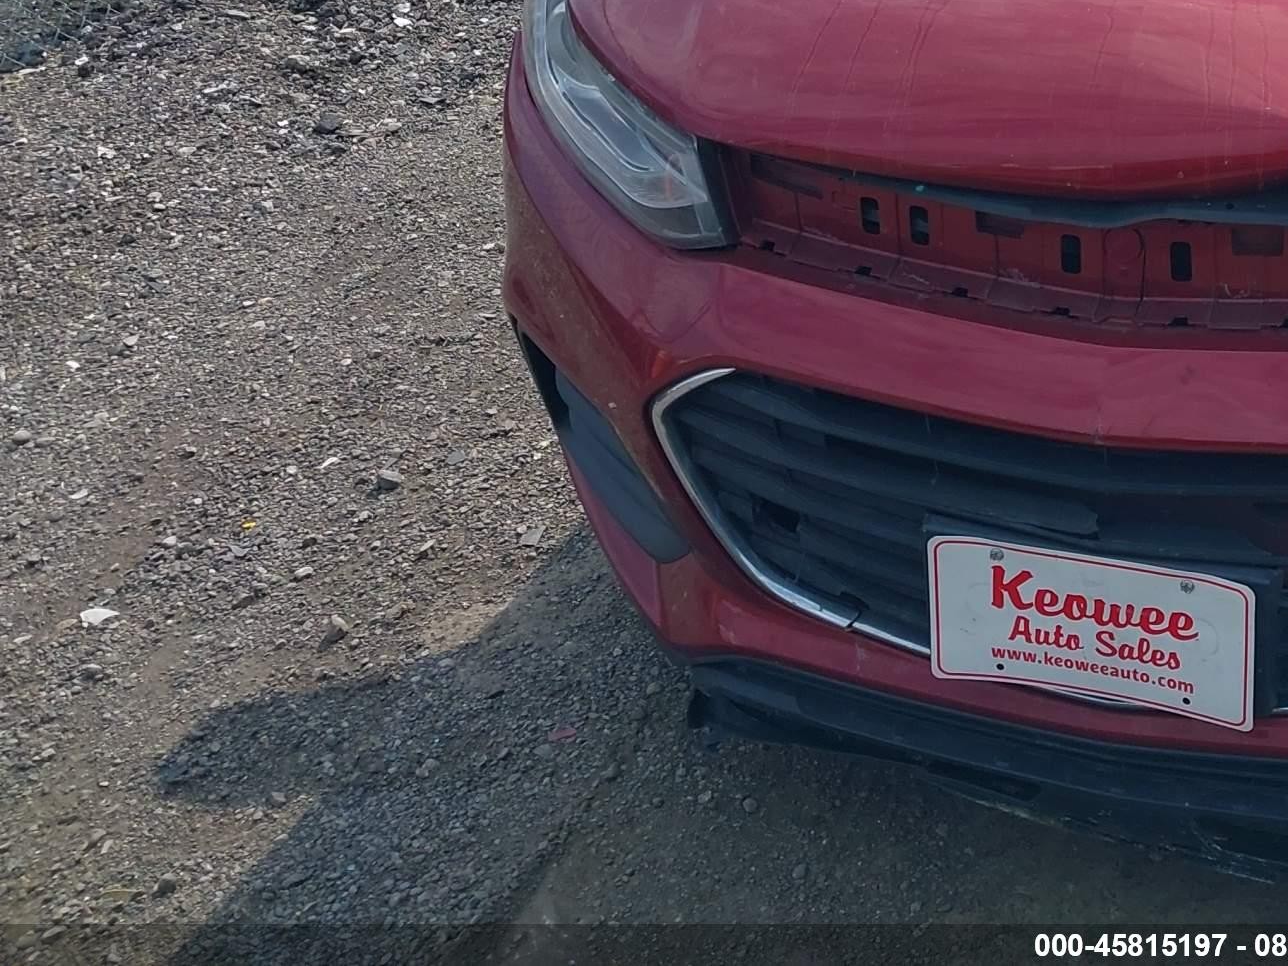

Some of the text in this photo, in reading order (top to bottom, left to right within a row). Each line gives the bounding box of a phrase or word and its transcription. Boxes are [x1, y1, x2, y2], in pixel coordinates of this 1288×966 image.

[991, 565, 1199, 641] Keowee
[991, 646, 1194, 694] www.keoweeauto.com
[1008, 616, 1181, 670] Auto Sales
